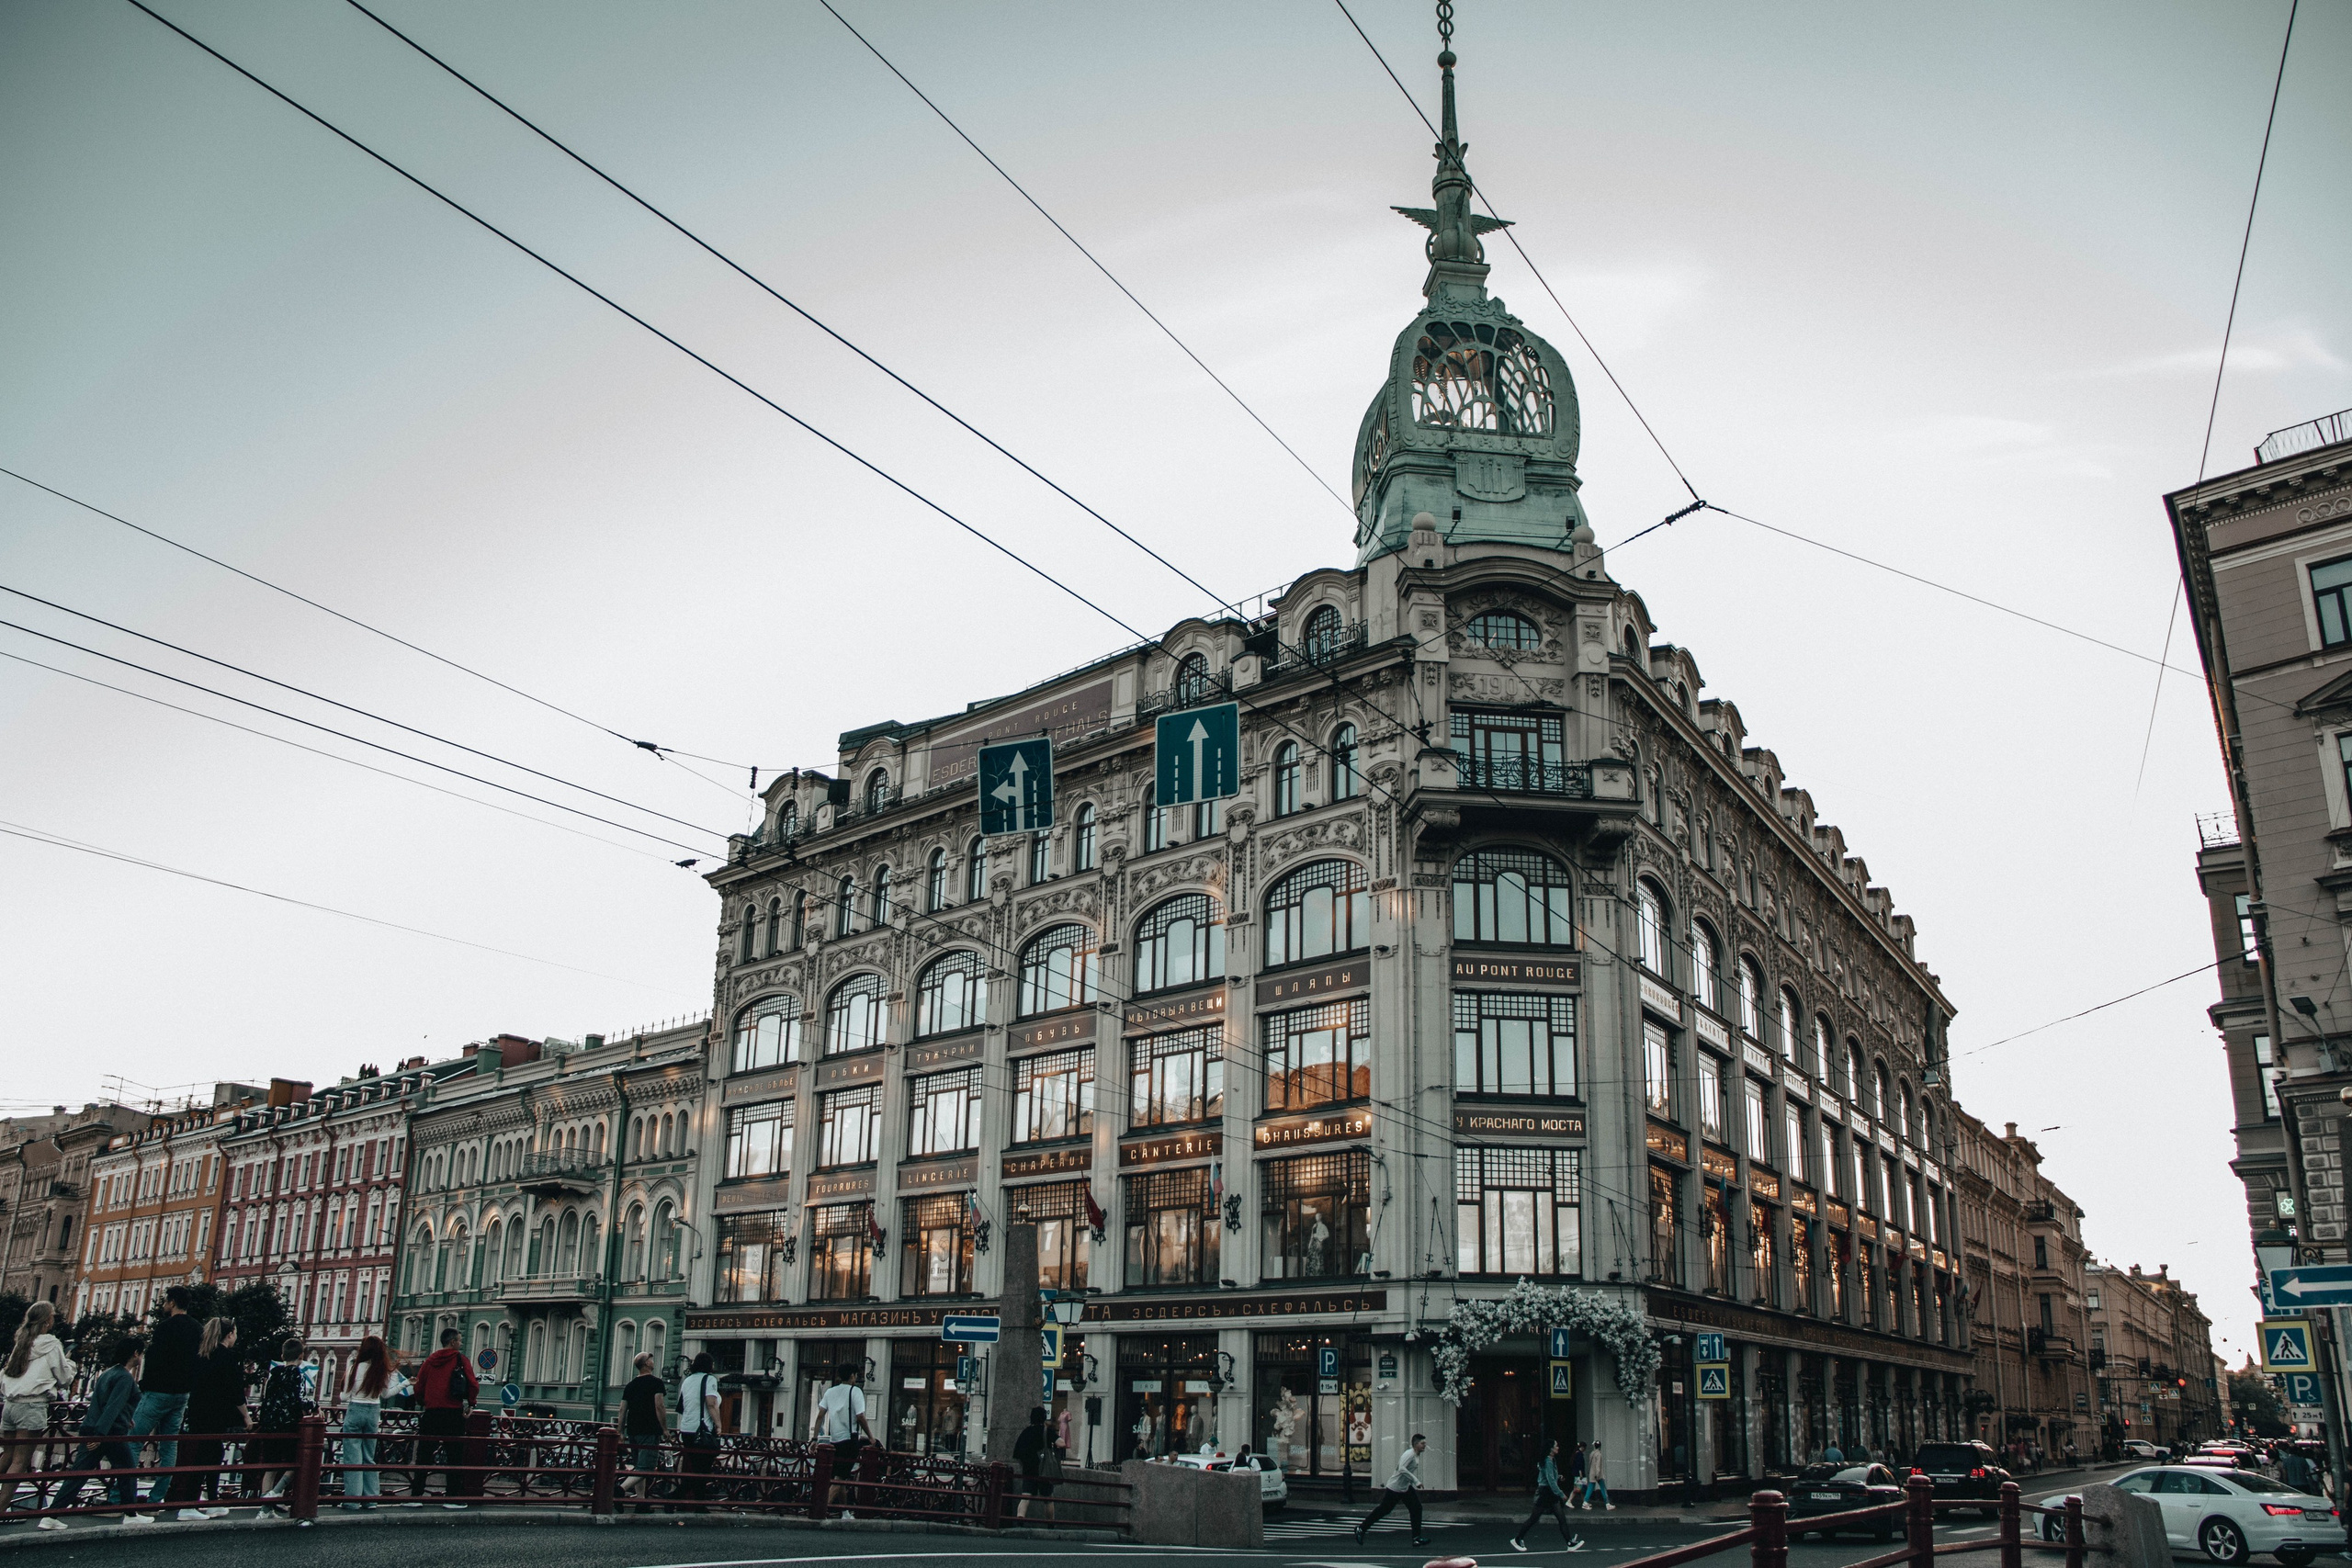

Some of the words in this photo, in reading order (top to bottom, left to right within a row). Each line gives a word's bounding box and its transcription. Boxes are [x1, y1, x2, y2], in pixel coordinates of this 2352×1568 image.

[988, 722, 1020, 739] PONT
[1035, 701, 1078, 724] ROUGE
[933, 755, 978, 782] ESDER
[1456, 964, 1475, 976] AU
[1480, 964, 1519, 976] PONT
[1525, 966, 1575, 979] ROUGE
[1275, 971, 1351, 997] ШЛЯПЫ
[1191, 996, 1223, 1012] ВЕЩИ
[1024, 1024, 1080, 1043] ОБУВЬ
[916, 1043, 975, 1063] ТУЖУРКИ
[831, 1063, 870, 1078] ЮБКИ
[1456, 1116, 1464, 1127] У
[1469, 1117, 1535, 1130] КРАСНАГО
[1541, 1118, 1583, 1131] МОСТА
[1011, 1155, 1084, 1173] CHAPEAUX
[908, 1168, 969, 1184] LINGERIE
[816, 1179, 870, 1194] FOURRURES
[1132, 1304, 1221, 1319] ЭСДЕРСЪ
[1242, 1299, 1371, 1315] СХЕФАЛЬСЪ
[690, 1317, 741, 1329] ЭСДЕРСЪ
[753, 1315, 827, 1328] СХЕФАЛЬСЪ
[841, 1310, 922, 1325] МАГАЗИНЪ
[931, 1310, 938, 1324] У
[2292, 1375, 2312, 1400] P
[901, 1417, 917, 1427] SALE
[1132, 1424, 1152, 1434] SALE
